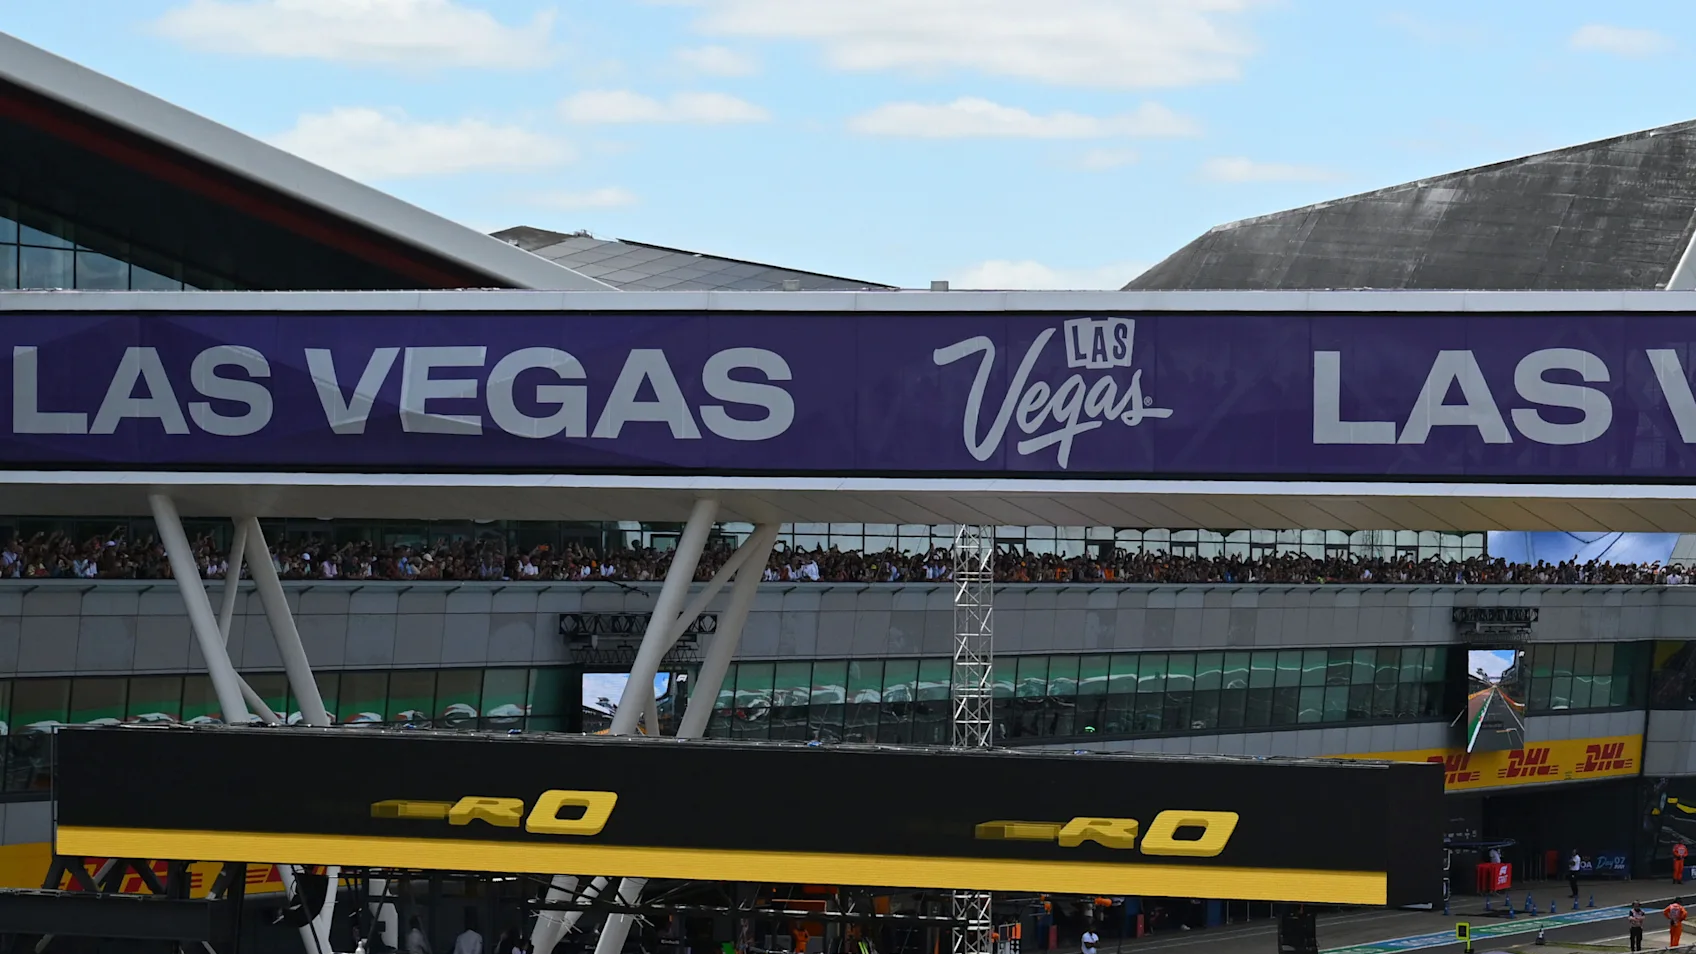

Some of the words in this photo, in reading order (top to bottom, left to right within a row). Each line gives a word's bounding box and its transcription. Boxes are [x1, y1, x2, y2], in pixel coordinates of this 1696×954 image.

[1073, 321, 1130, 363] LAS
[12, 345, 272, 436] LAS
[303, 345, 796, 442] VEGAS
[933, 326, 1173, 470] Vegas
[1312, 348, 1613, 445] LAS
[1584, 743, 1626, 772] DHL
